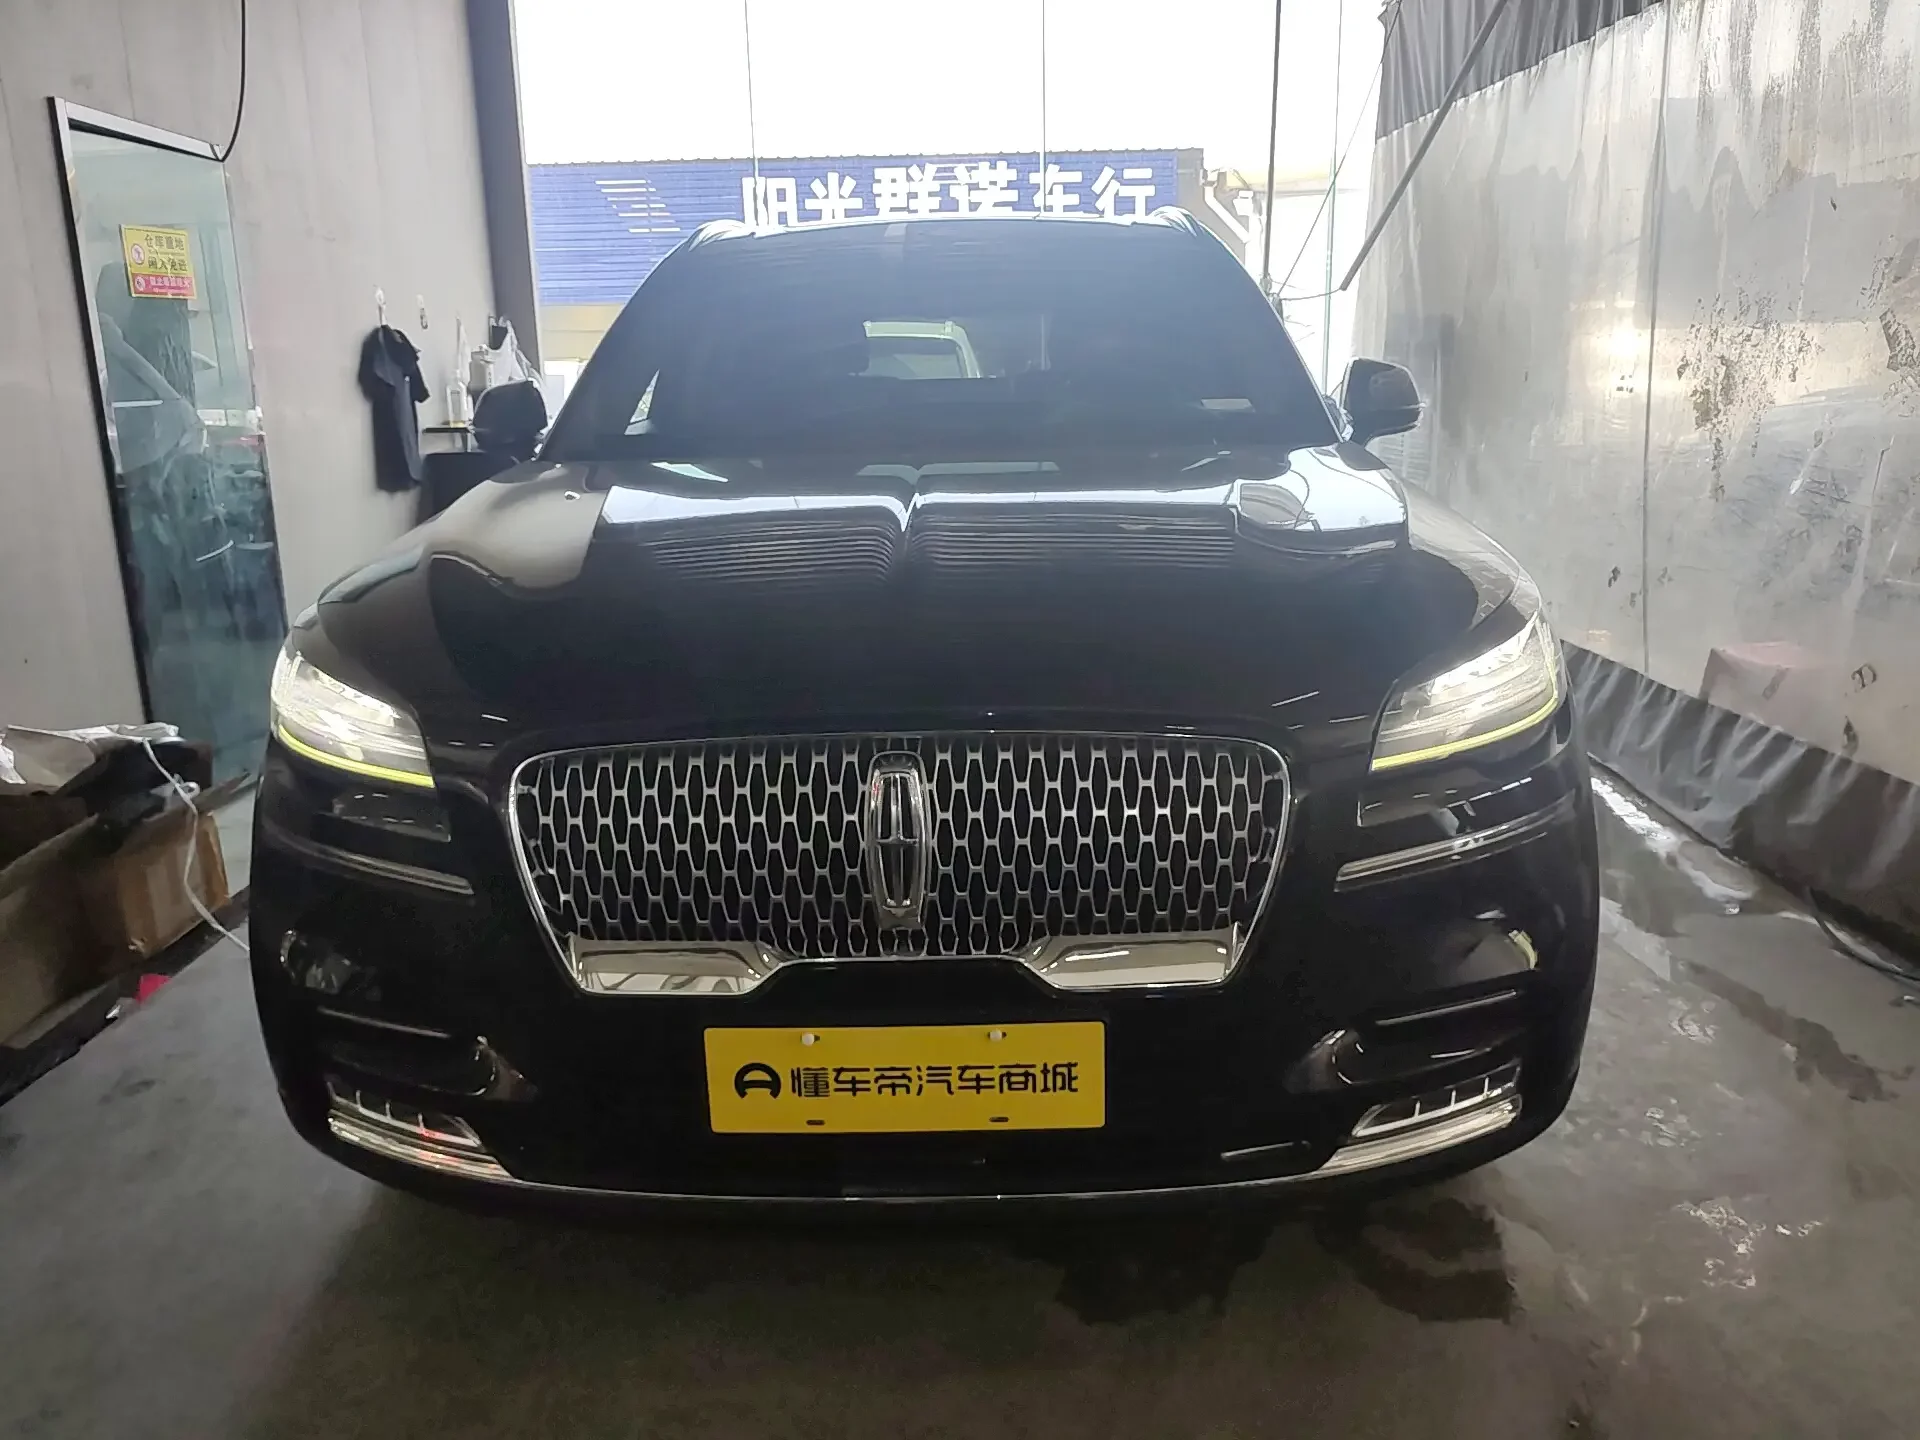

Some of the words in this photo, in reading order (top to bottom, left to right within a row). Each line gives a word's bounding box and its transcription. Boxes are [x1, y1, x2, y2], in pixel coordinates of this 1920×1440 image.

[790, 1061, 1079, 1098] 懂车帝汽车商城
